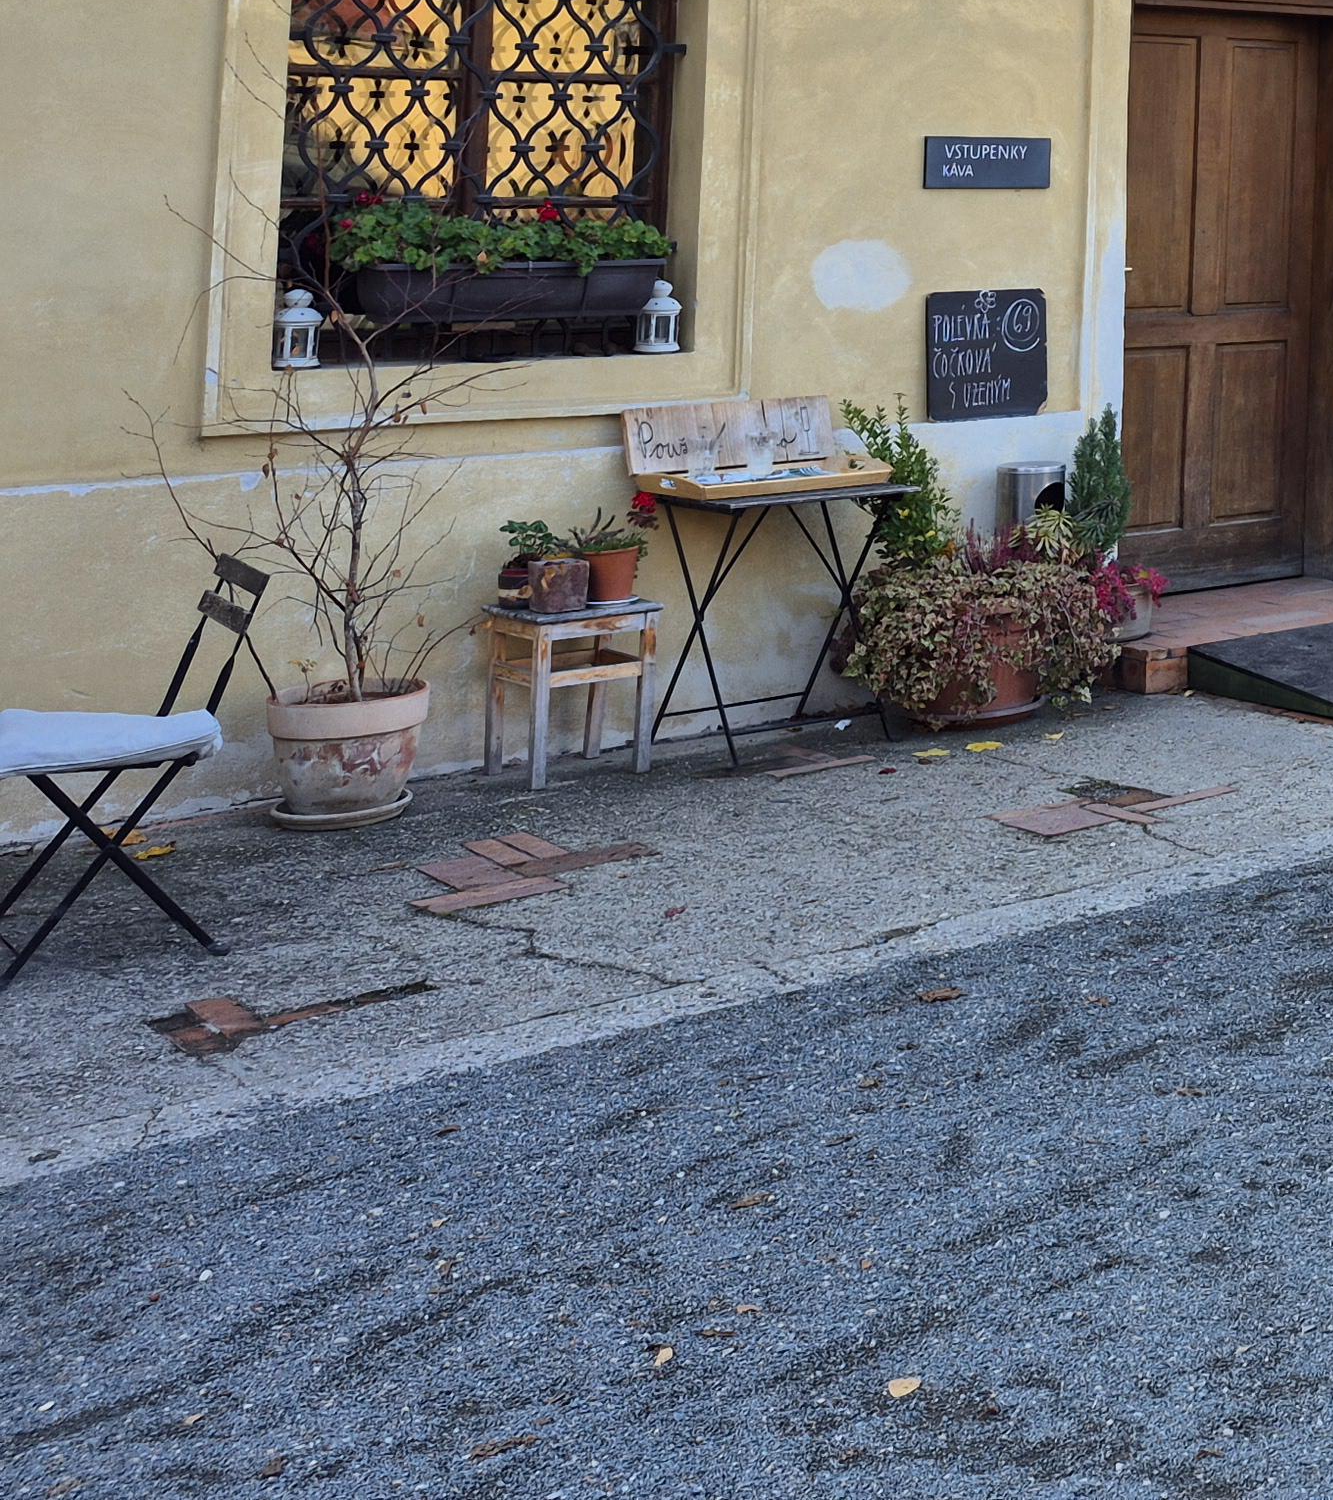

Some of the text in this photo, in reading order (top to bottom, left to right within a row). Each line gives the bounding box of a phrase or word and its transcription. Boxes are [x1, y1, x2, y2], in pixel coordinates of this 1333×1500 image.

[944, 144, 1028, 160] VSTUPENKY
[942, 162, 974, 178] KÁVA
[1012, 303, 1033, 334] 69
[932, 341, 997, 379] ČOČKOVÁ
